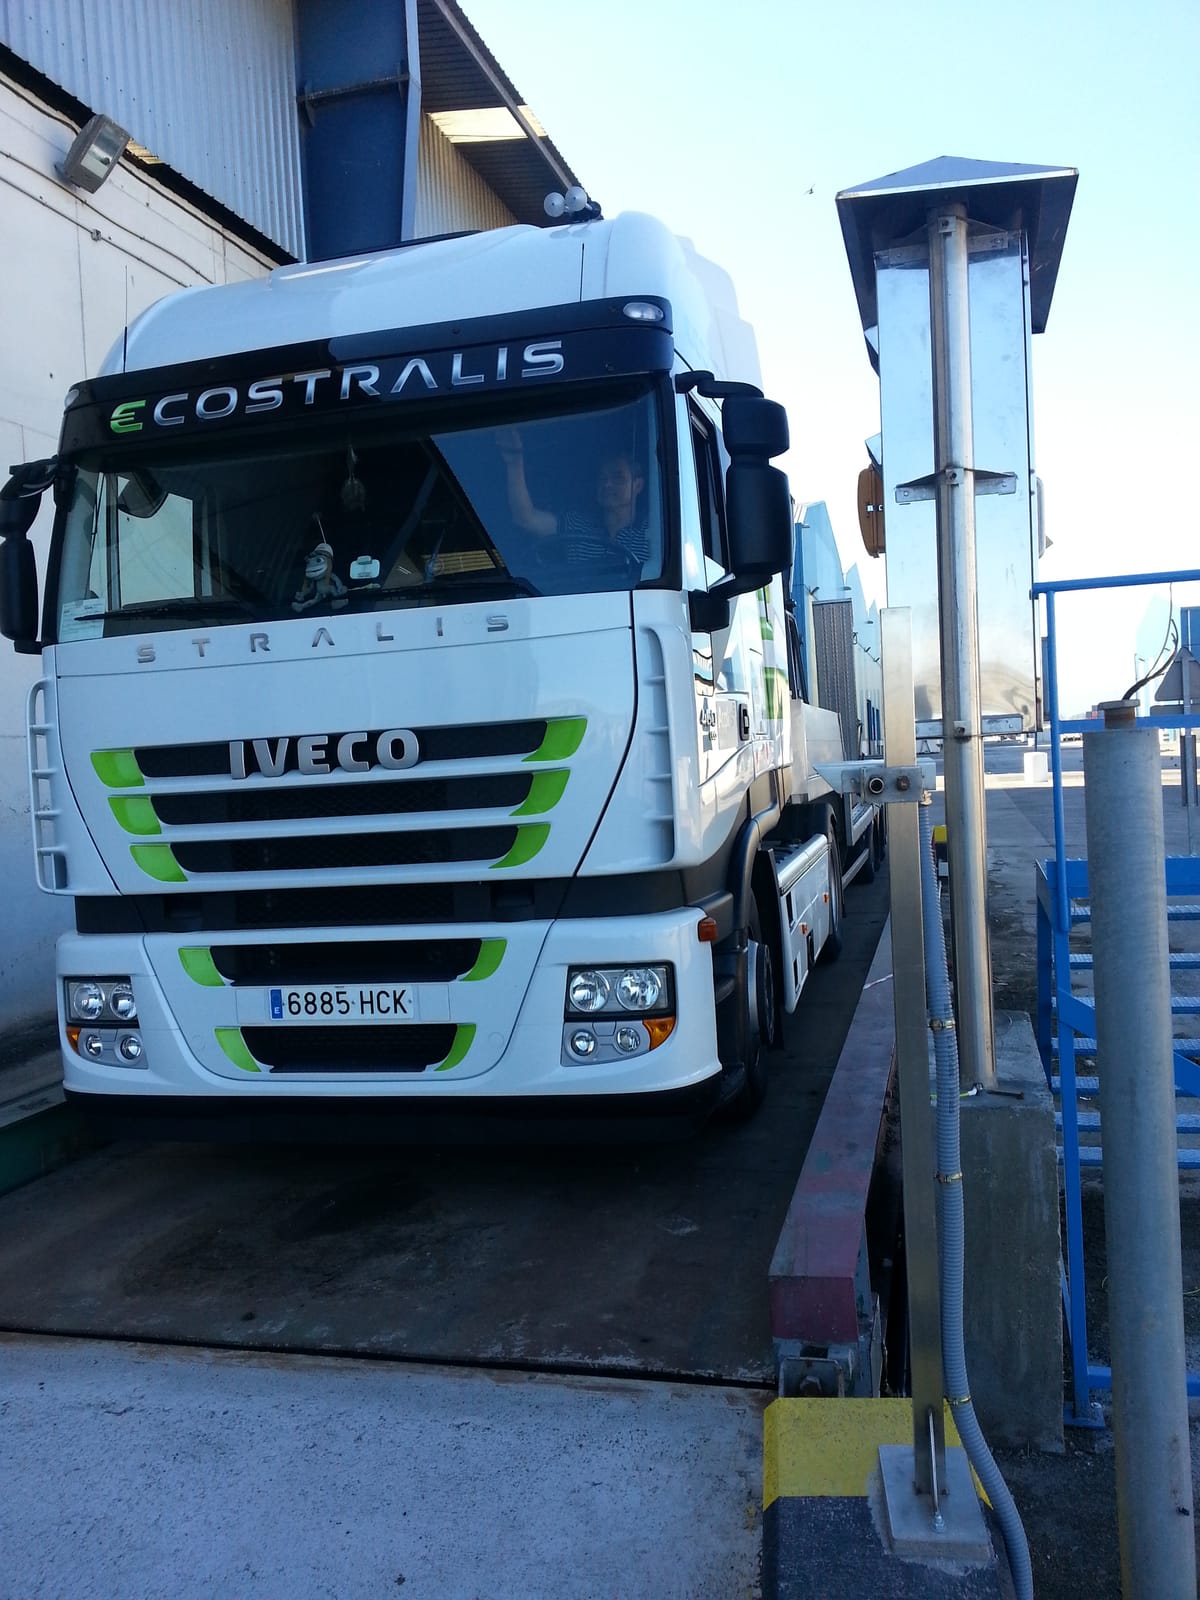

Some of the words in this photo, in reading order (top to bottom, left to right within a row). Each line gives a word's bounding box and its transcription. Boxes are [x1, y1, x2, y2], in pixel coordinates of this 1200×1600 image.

[109, 339, 566, 434] ECOSTRALIS
[136, 614, 509, 664] STRALIS
[228, 728, 420, 780] IVECO
[273, 1006, 281, 1014] E
[287, 991, 350, 1015] 6885
[359, 989, 408, 1015] HCK
